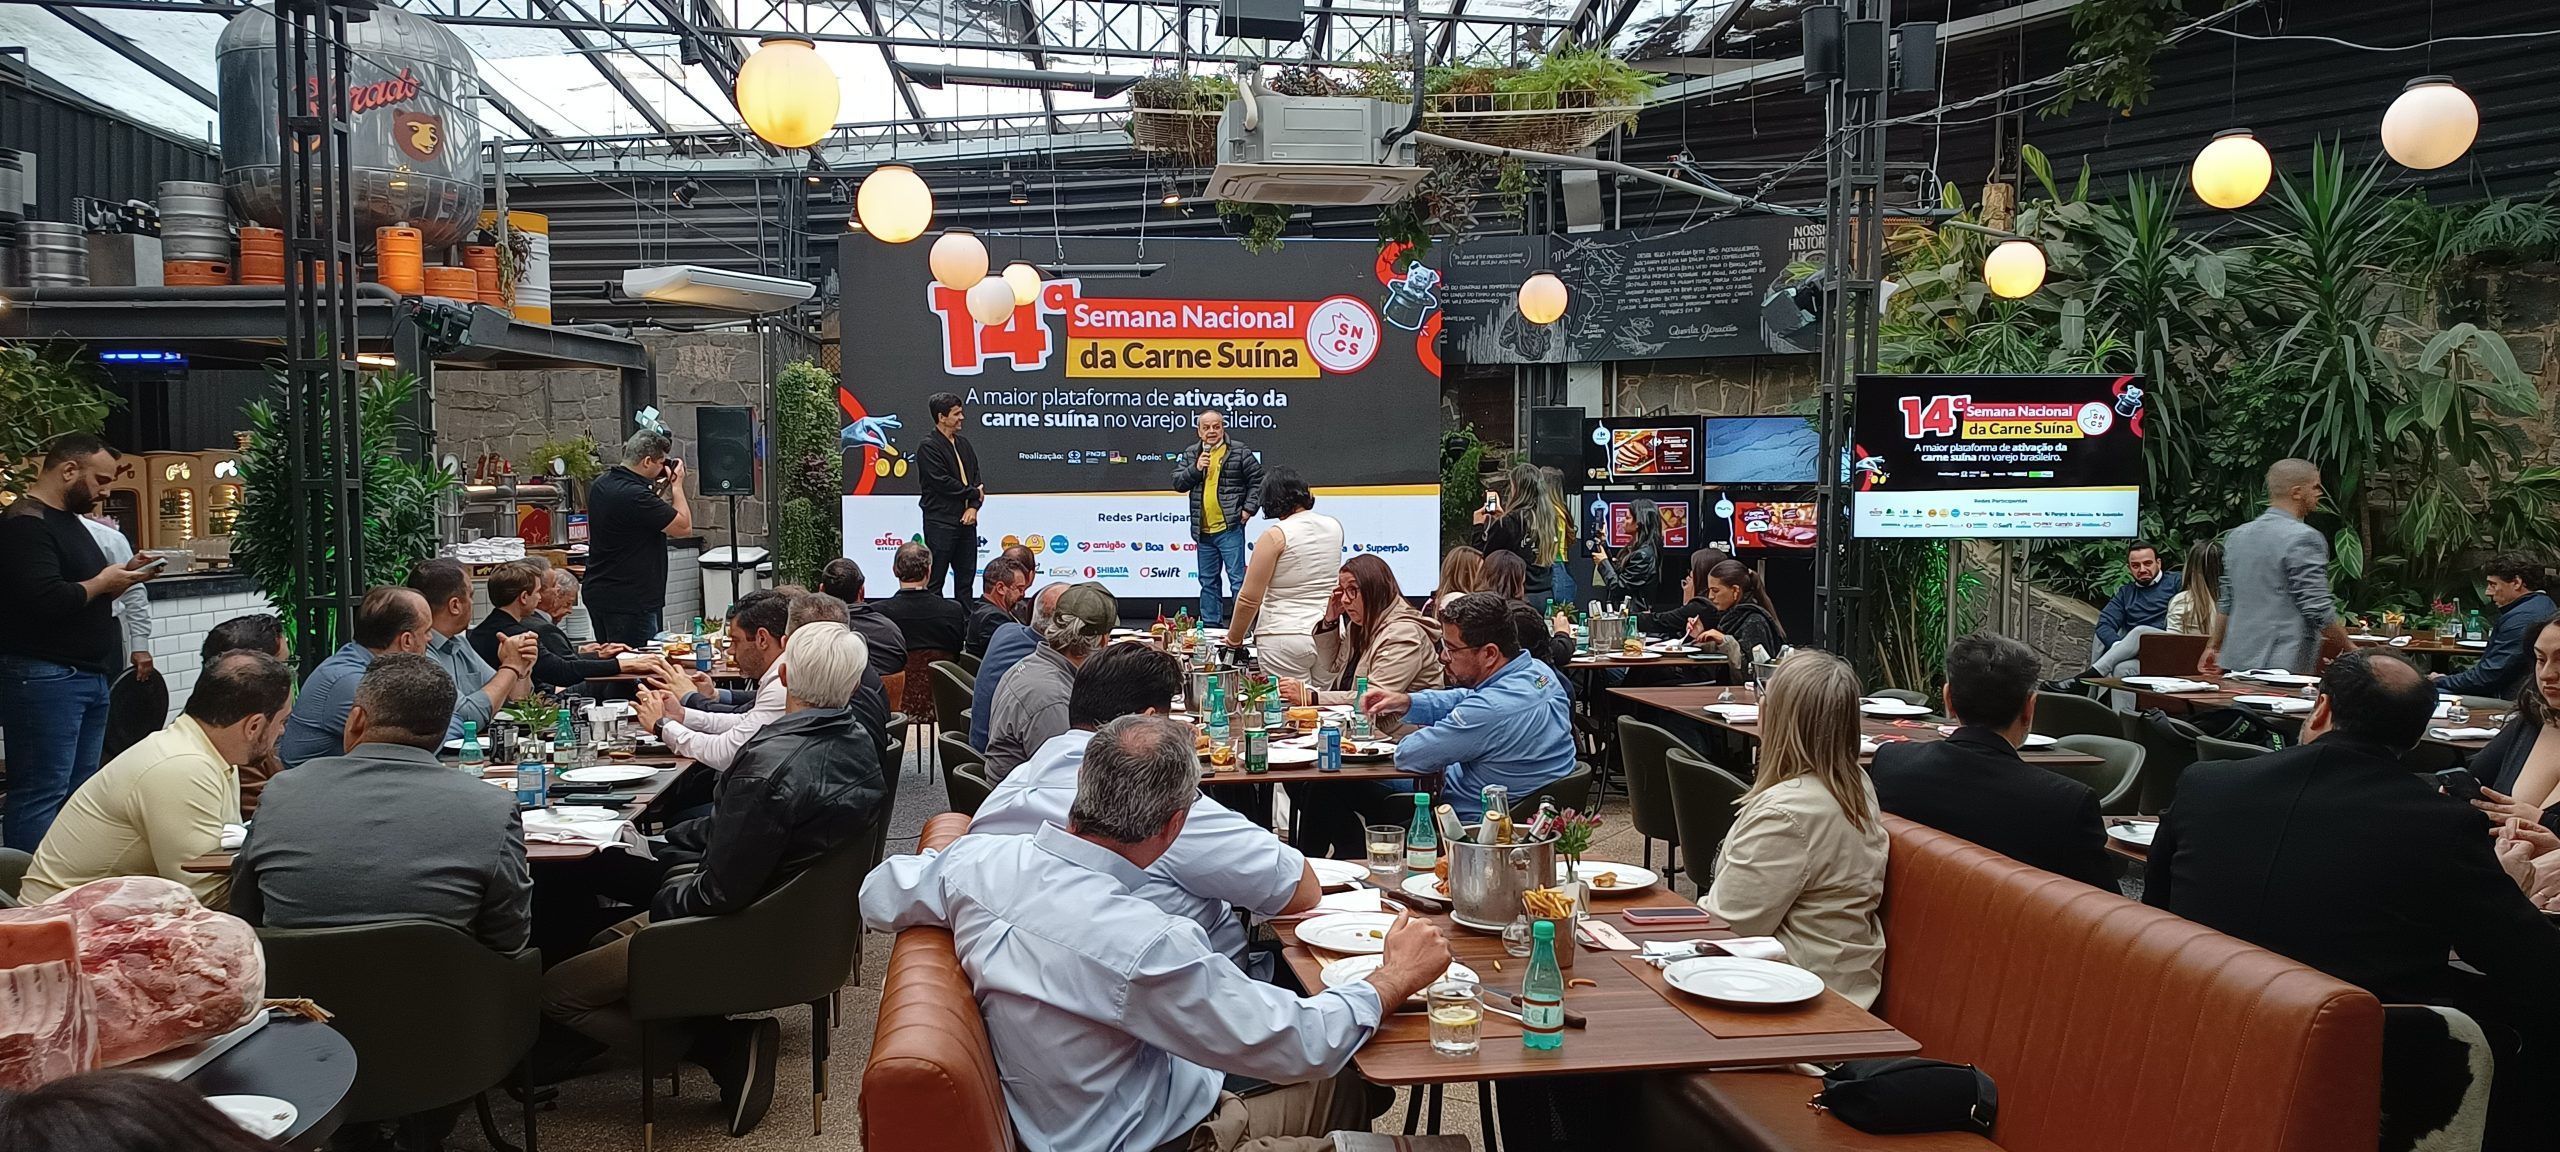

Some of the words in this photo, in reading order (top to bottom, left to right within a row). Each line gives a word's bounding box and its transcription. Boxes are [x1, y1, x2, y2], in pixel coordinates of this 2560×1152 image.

[1074, 303, 1177, 329] Semana
[1182, 304, 1295, 329] Nacional
[1080, 341, 1117, 370] da
[1122, 341, 1212, 370] Carne
[1216, 341, 1299, 369] Suína
[965, 388, 980, 406] A
[983, 387, 1038, 407] maior
[1042, 387, 1142, 410] plataforma
[1146, 388, 1170, 407] de
[1173, 389, 1259, 411] ativação
[1262, 389, 1288, 407] da
[1966, 405, 2016, 418] Semana
[2017, 405, 2073, 418] Nacional
[981, 411, 1040, 428] carne
[1044, 409, 1099, 428] suína
[1104, 412, 1127, 428] no
[1131, 410, 1186, 433] varejo
[1191, 409, 1278, 429] bsileiro.
[1969, 422, 1986, 435] da
[1989, 422, 2032, 435] Carne
[2034, 421, 2073, 435] Suína
[1914, 443, 1922, 452] A
[1922, 443, 1949, 452] maior
[1949, 443, 1998, 454] plataforma
[1998, 443, 2011, 452] de
[2011, 442, 2054, 454] ativação
[2054, 442, 2068, 452] da
[1135, 453, 1162, 463] Apoio:
[1921, 454, 1949, 463] carne
[1949, 453, 1977, 463] suína
[1978, 454, 1990, 462] no
[1991, 454, 2019, 464] varejo
[2019, 452, 2063, 463] brasileiro.
[1097, 512, 1133, 523] Redes
[874, 534, 903, 546] extra
[1092, 540, 1127, 550] amigão
[1144, 542, 1164, 552] Boa
[1365, 543, 1410, 554] Superpão
[1096, 566, 1129, 574] SHIBATA
[1150, 567, 1182, 578] Swift
